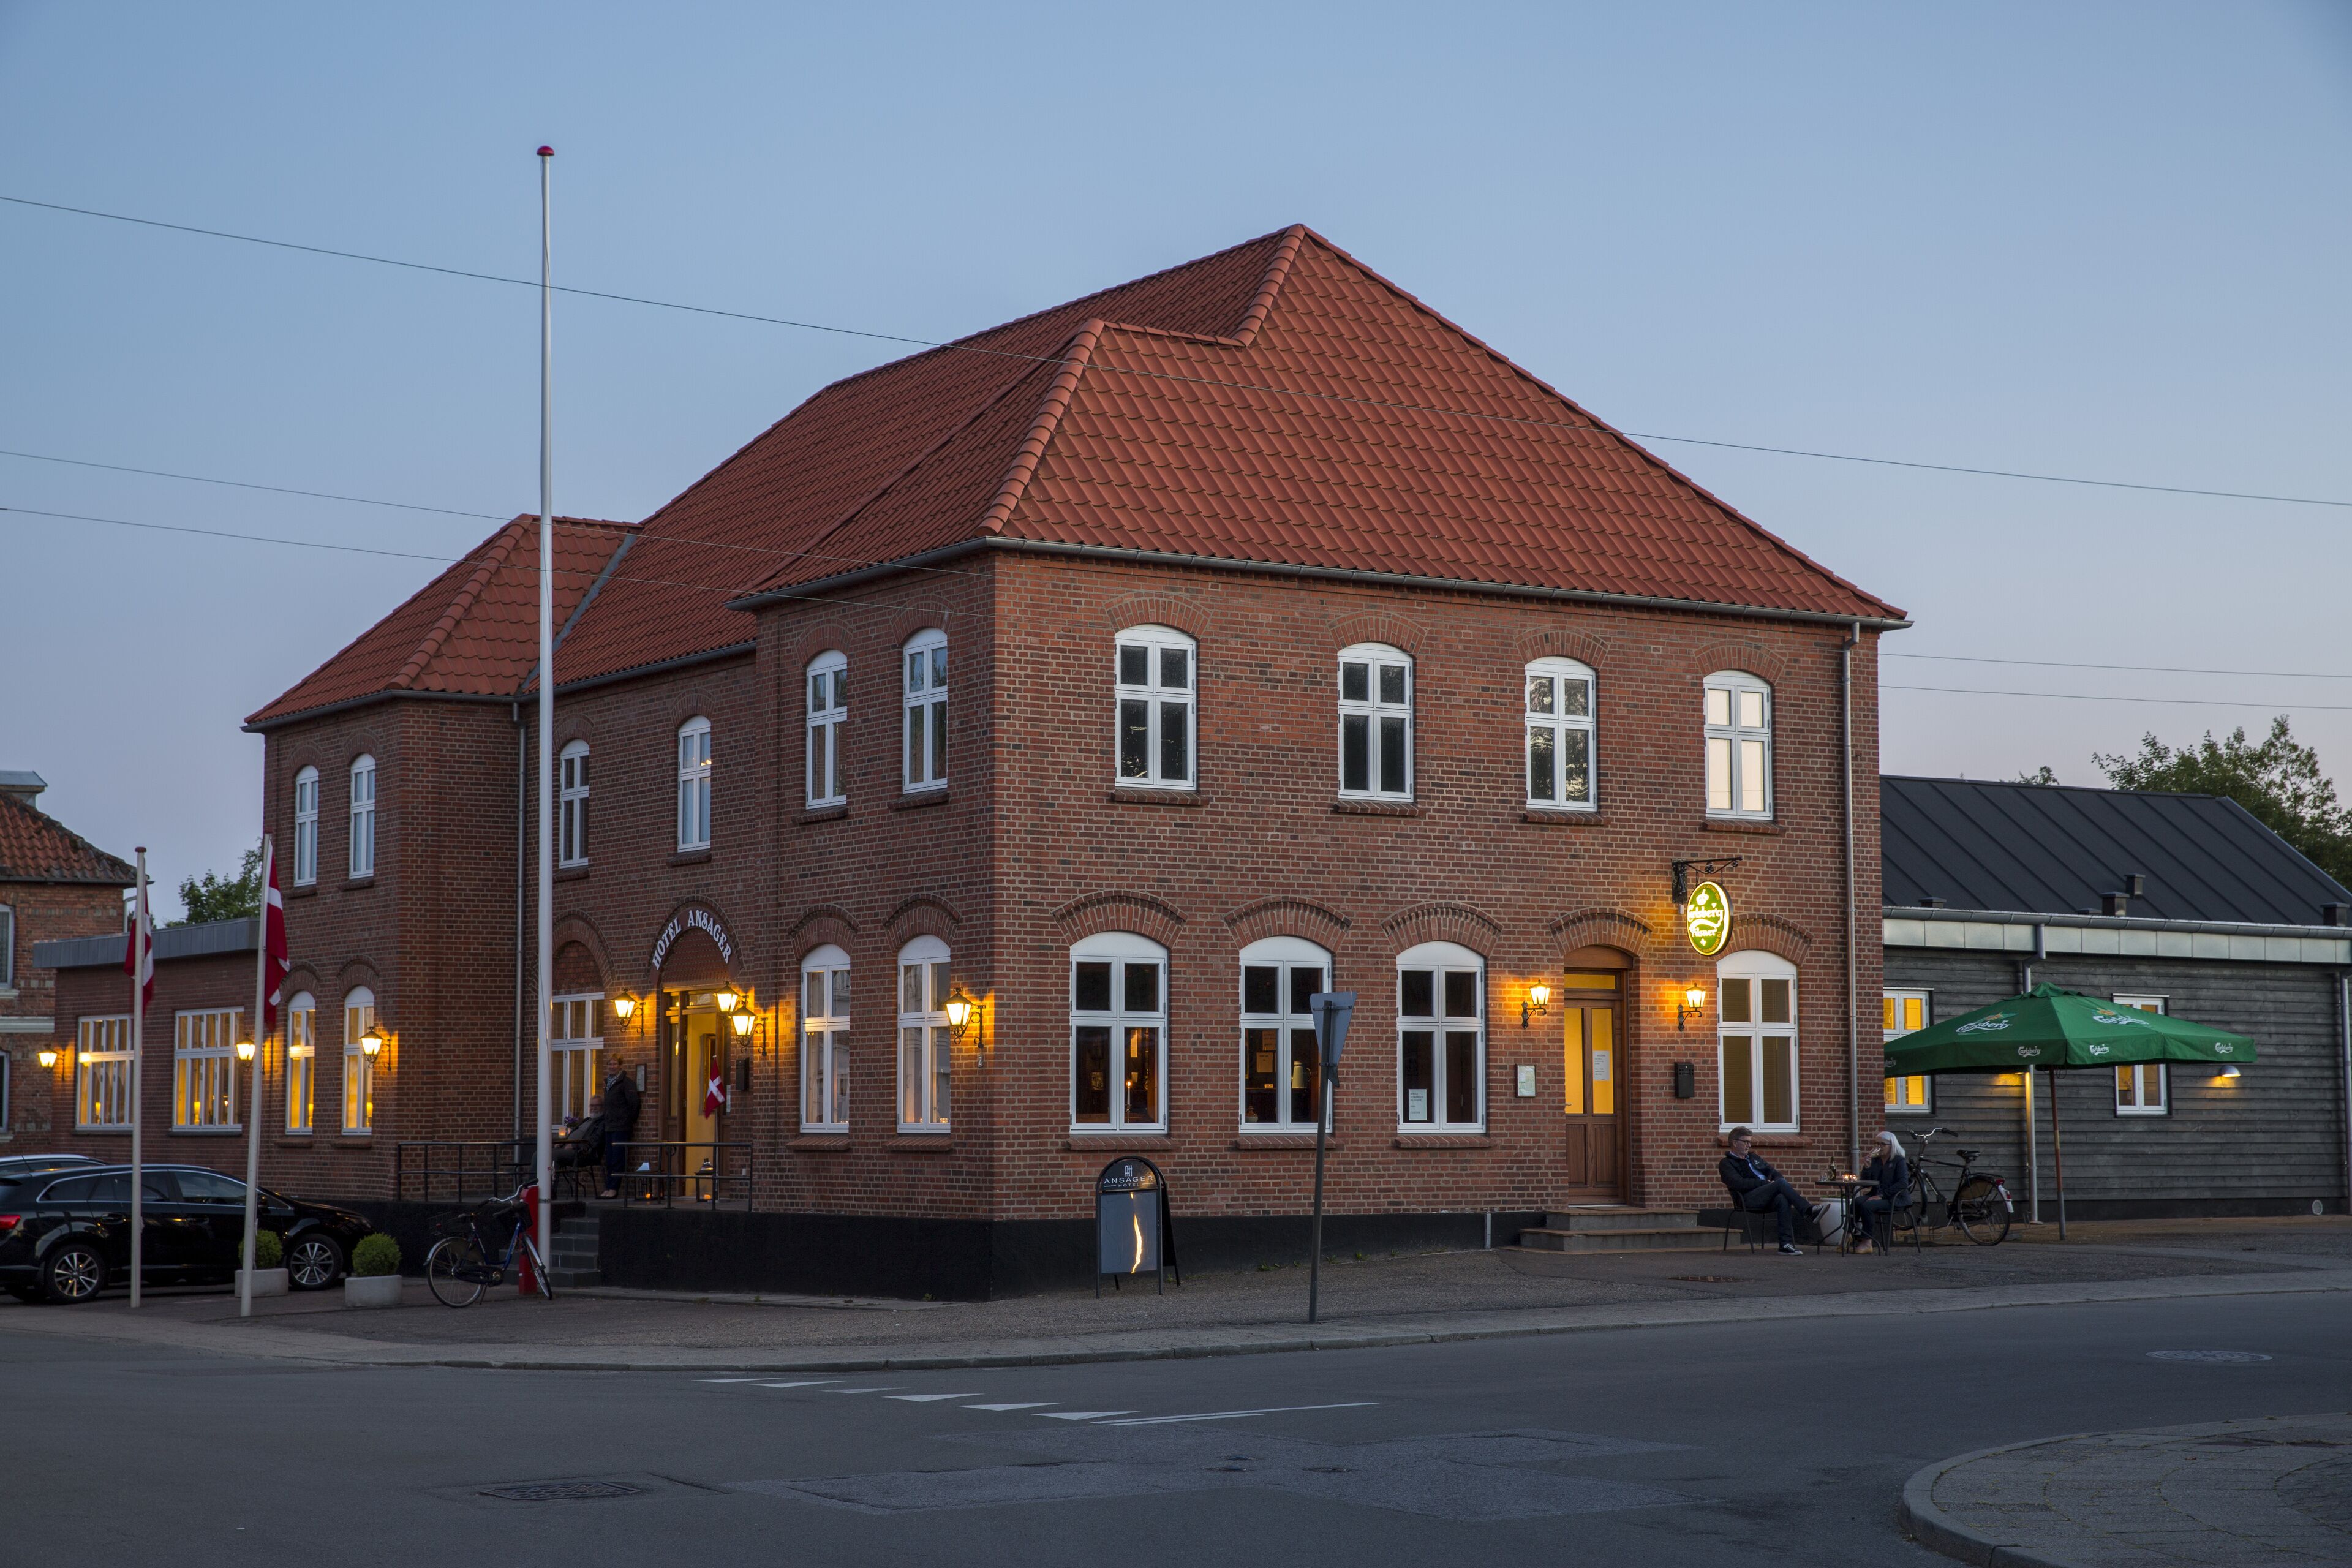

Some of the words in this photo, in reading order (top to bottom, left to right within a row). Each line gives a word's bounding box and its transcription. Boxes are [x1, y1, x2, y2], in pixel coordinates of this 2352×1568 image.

[1687, 904, 1724, 922] Carlsberg
[652, 917, 682, 970] HOTEL
[688, 910, 731, 964] ANSAGER
[1955, 1020, 2010, 1033] Carlsberg
[2018, 1046, 2041, 1057] Carlsberg
[2089, 1044, 2109, 1056] Carlsberg
[2215, 1042, 2234, 1054] Carlsberg
[979, 1057, 982, 1065] 2
